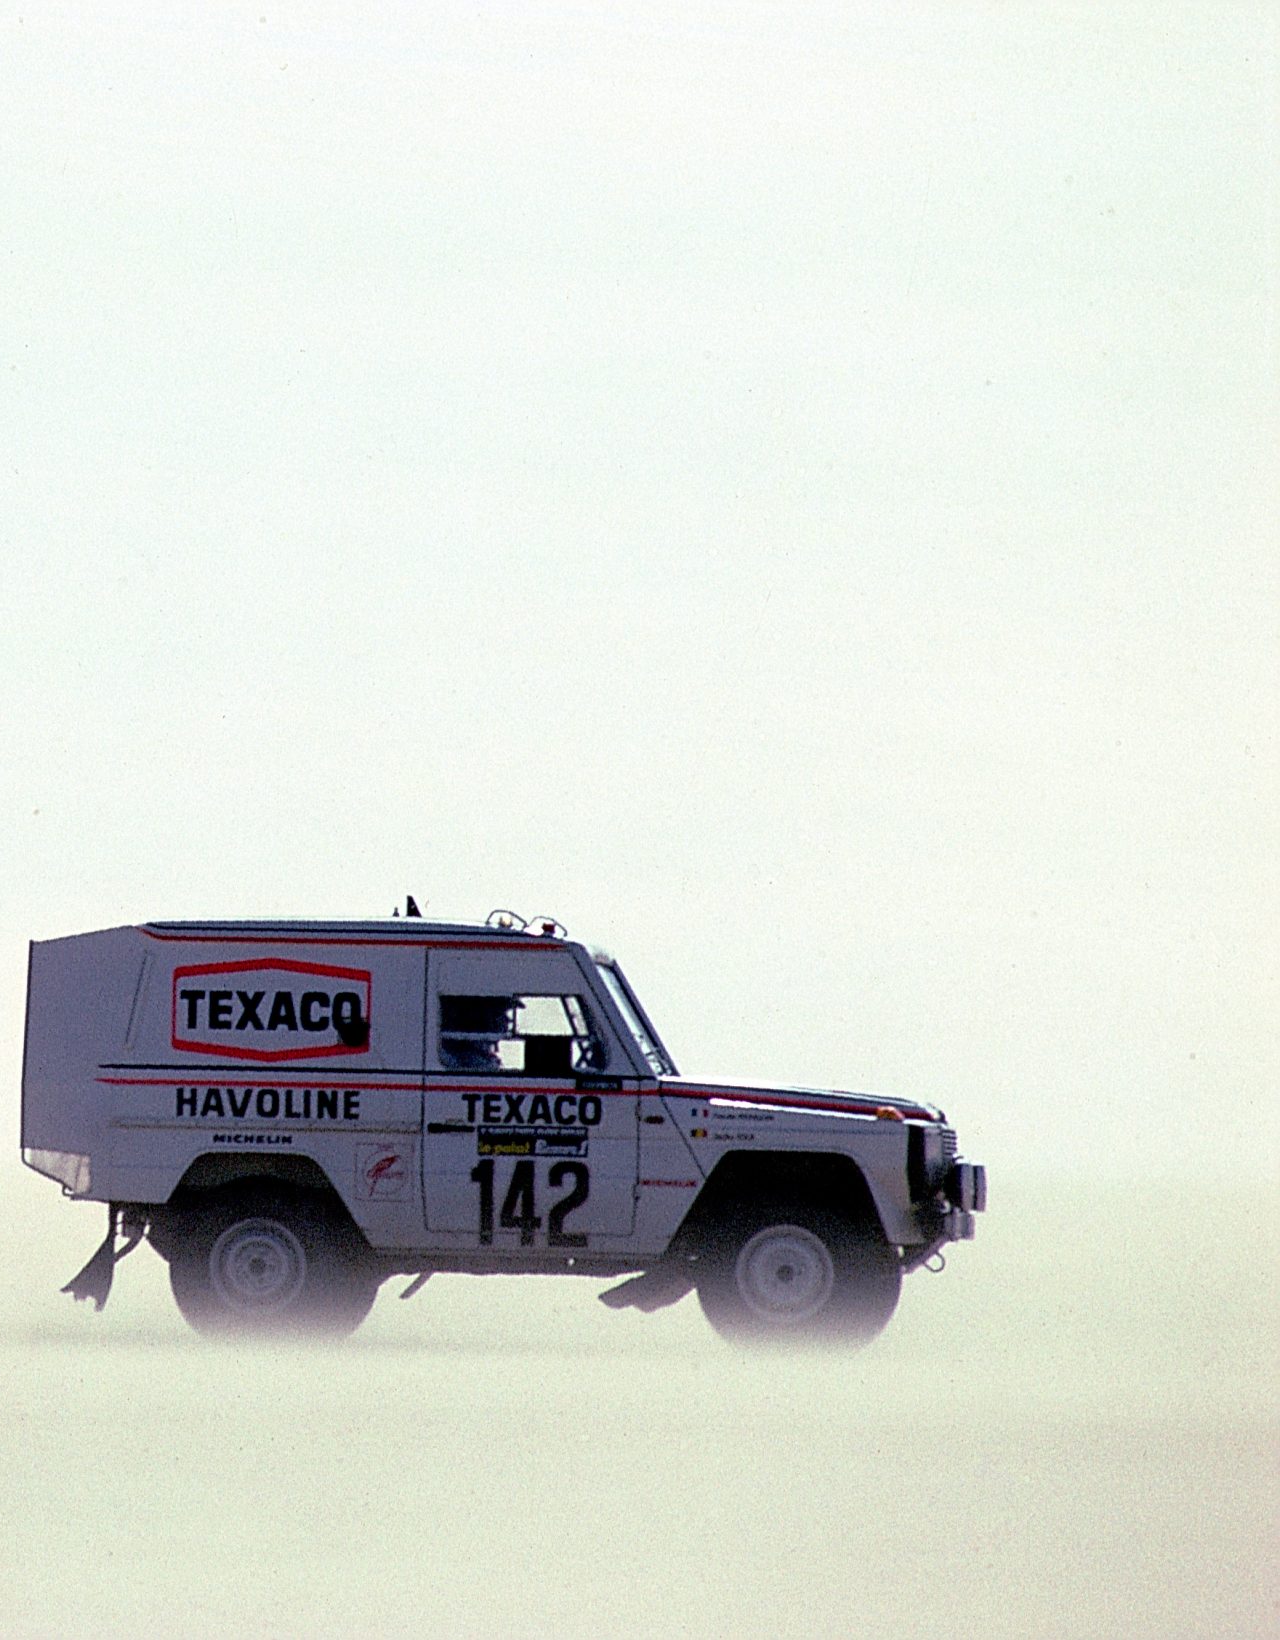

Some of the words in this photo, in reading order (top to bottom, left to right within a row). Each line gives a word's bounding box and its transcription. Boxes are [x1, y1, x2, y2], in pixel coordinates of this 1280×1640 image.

[180, 989, 362, 1032] TEXACO
[176, 1087, 360, 1120] HAVOLINE
[462, 1094, 602, 1125] TEXACO
[213, 1134, 293, 1145] MICHELIN
[471, 1158, 590, 1247] 142
